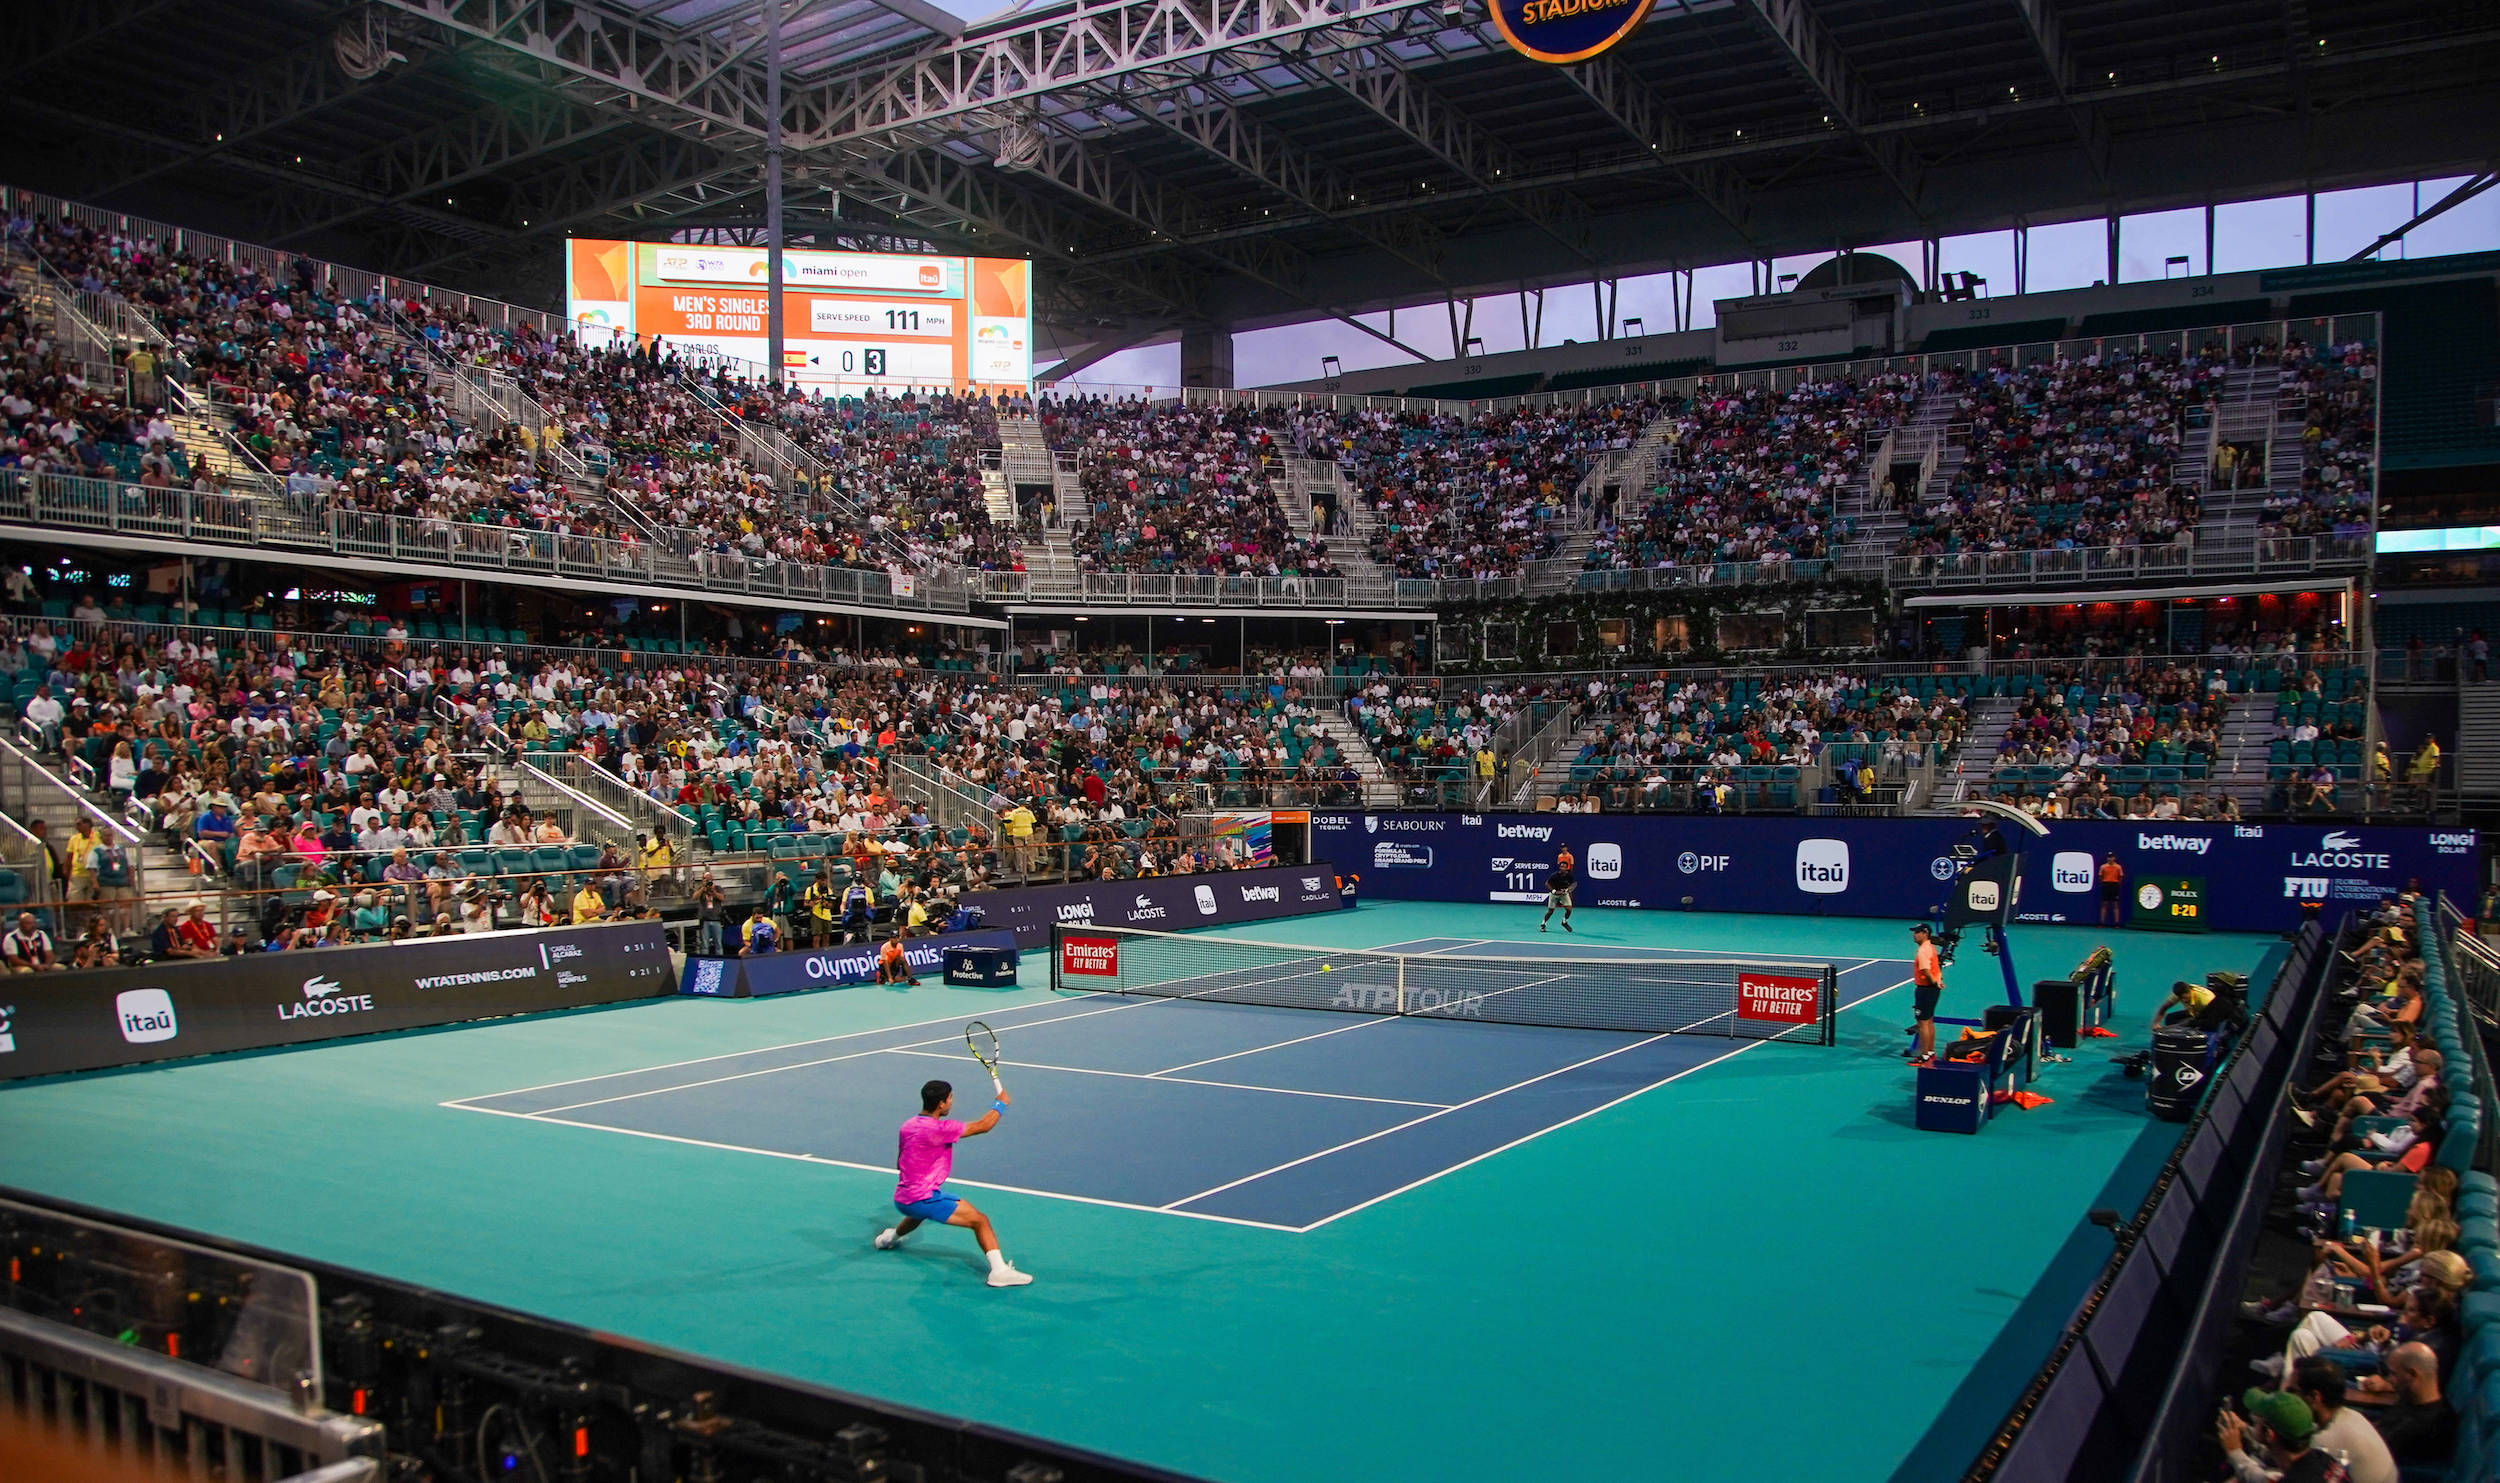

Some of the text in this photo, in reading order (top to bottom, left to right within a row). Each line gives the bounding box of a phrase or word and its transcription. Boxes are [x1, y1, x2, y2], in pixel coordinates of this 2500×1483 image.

[802, 265, 868, 279] miami open
[2191, 286, 2214, 298] 334
[673, 296, 716, 313] MEN'S
[817, 313, 870, 323] SERVE SPEED
[885, 310, 919, 330] 111
[926, 317, 945, 325] MPH
[1968, 308, 1990, 320] 333
[686, 314, 760, 331] 3RD ROUND
[1624, 346, 1643, 357] 331
[1777, 341, 1798, 352] 332
[842, 351, 853, 372] 0
[868, 351, 881, 373] 3
[1463, 365, 1482, 376] 330
[1324, 382, 1341, 392] 329
[1313, 816, 1352, 825] DOBEL
[1383, 820, 1444, 832] SEABOURN
[1498, 823, 1553, 842] betway
[2138, 833, 2212, 855] betway
[1493, 860, 1509, 869] SAP
[1532, 862, 1549, 870] SPEED
[1701, 855, 1730, 872] PIF
[2291, 852, 2391, 869] LACOSTE
[1505, 872, 1534, 890] 111
[2284, 877, 2329, 898] FIU
[1241, 885, 1279, 903] betway
[1301, 892, 1330, 902] CADILLAC
[2171, 889, 2198, 898] ROLEX
[1597, 899, 1627, 907] LACOSTE
[1127, 907, 1167, 922] LACOSTE
[552, 949, 583, 959] ALCARAZ
[1066, 943, 1115, 958] Emirates
[1073, 958, 1107, 970] FLY BETTER
[415, 965, 536, 990] WTATENNIS.COM
[952, 968, 984, 980] Protective
[1742, 980, 1814, 1002] Emirates
[1330, 982, 1483, 1016] ATP TOUR
[278, 994, 374, 1020] LACOSTE
[1752, 999, 1803, 1016] FLY BETTER
[1923, 1095, 1972, 1106] DUNLOP
